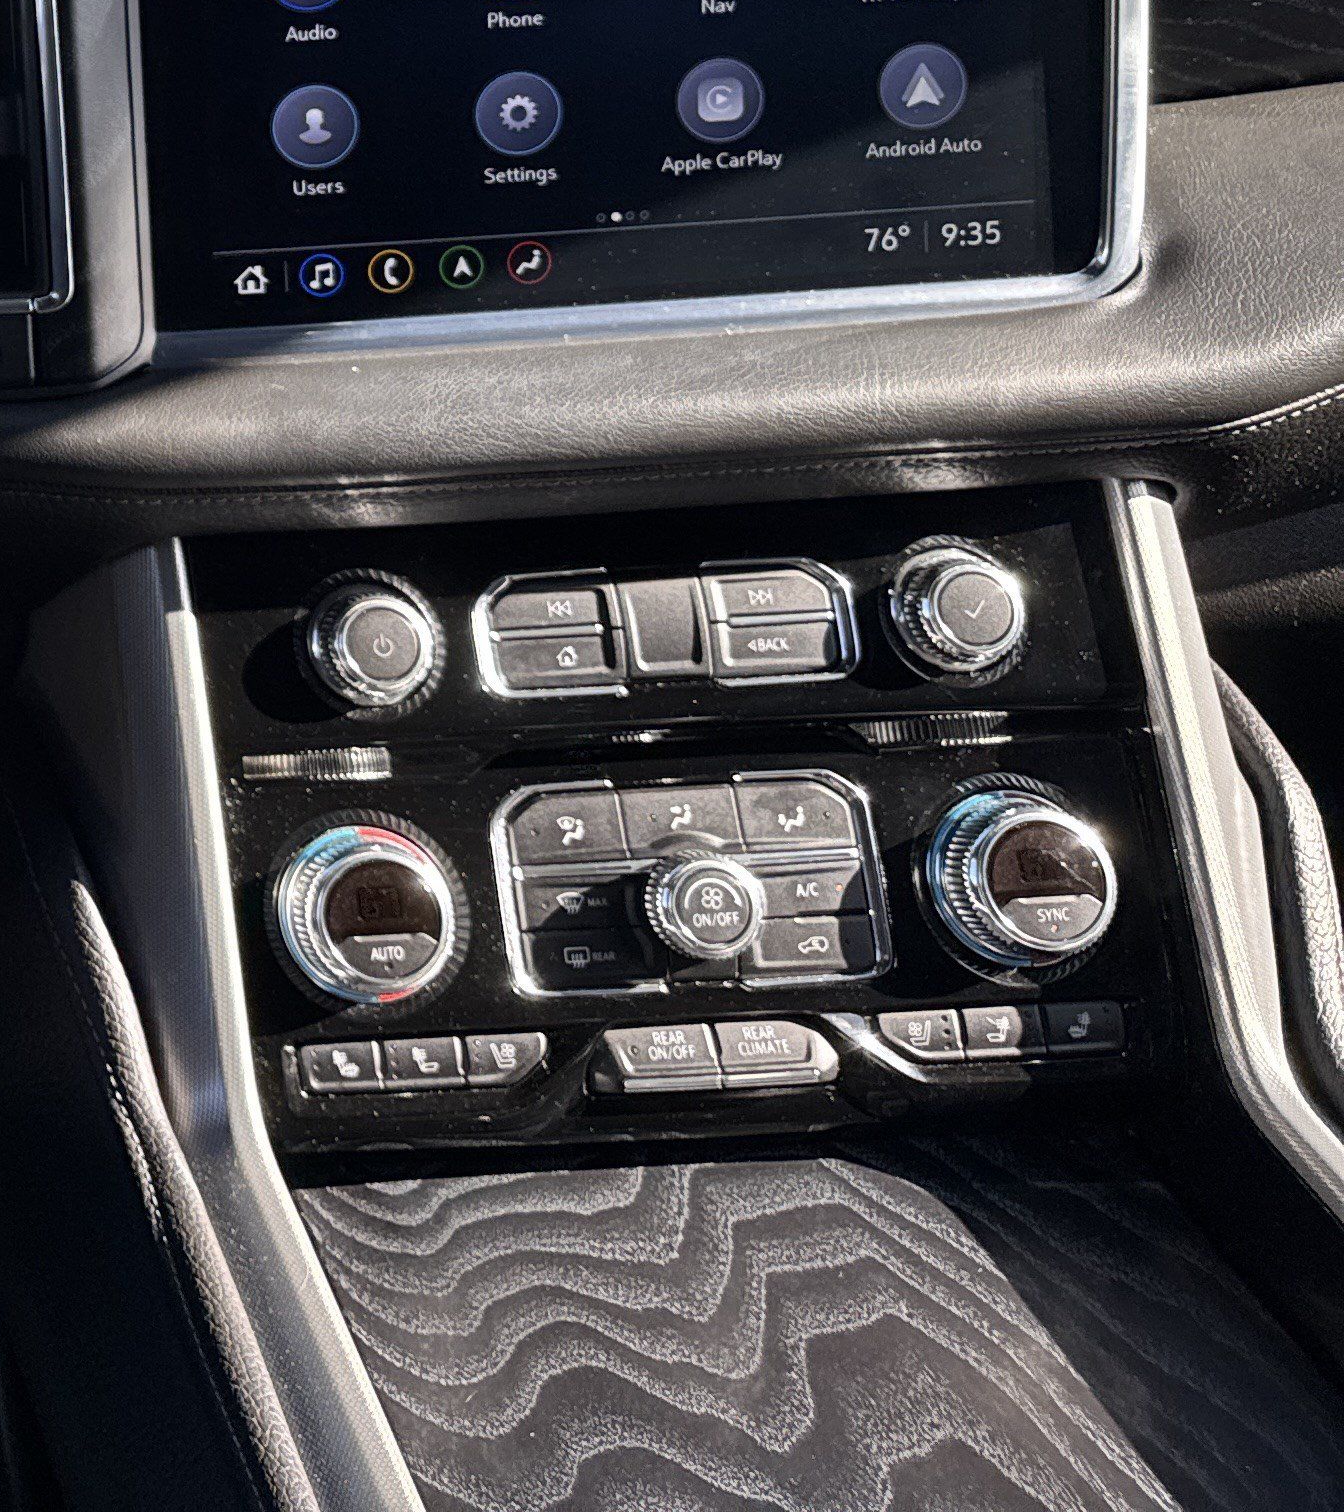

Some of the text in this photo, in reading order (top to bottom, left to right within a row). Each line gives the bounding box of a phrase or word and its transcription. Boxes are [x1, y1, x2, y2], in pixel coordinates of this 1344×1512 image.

[487, 10, 545, 29] Phone
[285, 23, 339, 43] Audio
[865, 136, 983, 159] Android Auto
[660, 149, 783, 176] Apple CarPlay
[483, 165, 559, 188] Settings
[292, 178, 345, 198] Users
[941, 220, 1002, 248] 9:35
[757, 637, 790, 652] BACK
[795, 883, 820, 898] A/C
[692, 911, 740, 929] ON/OFF
[1036, 906, 1071, 924] SYNC
[370, 945, 406, 963] AUTO
[651, 1029, 687, 1045] REAR
[741, 1024, 777, 1040] REAR
[647, 1043, 697, 1062] ON/OFF
[737, 1039, 792, 1057] CLIMATE
